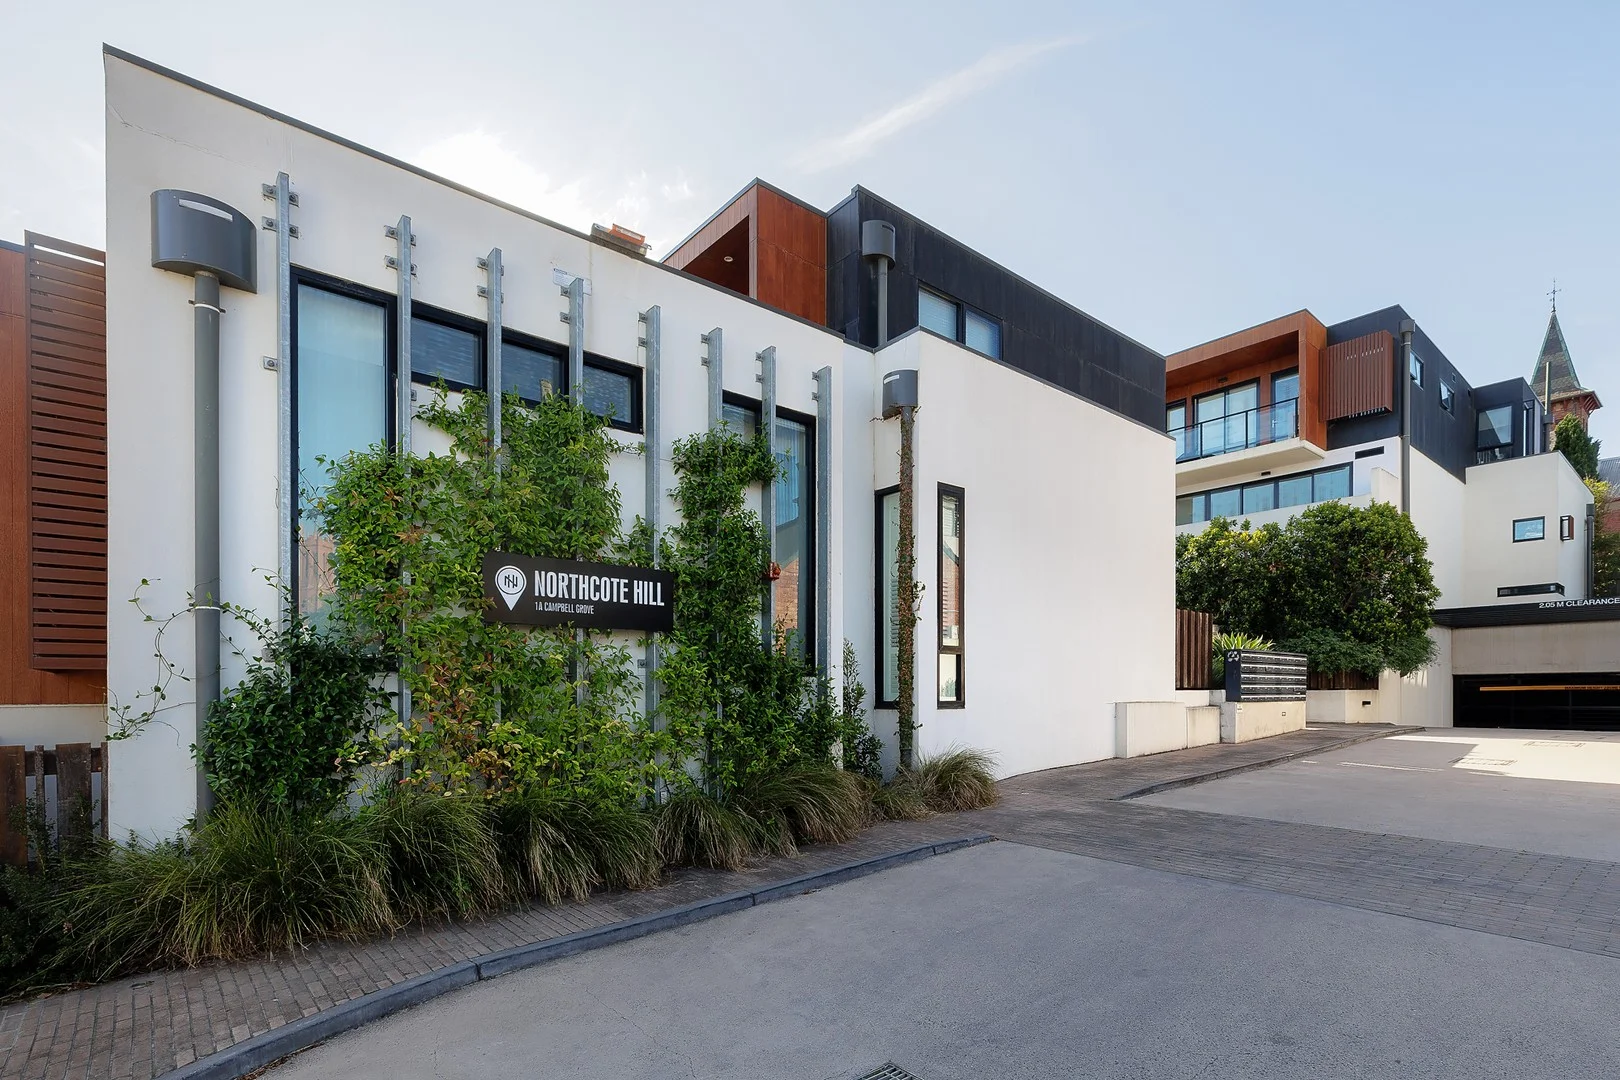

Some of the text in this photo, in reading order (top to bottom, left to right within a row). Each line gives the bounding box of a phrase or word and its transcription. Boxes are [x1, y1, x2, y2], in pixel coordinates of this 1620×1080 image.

[534, 570, 665, 606] NORTHCOTE HILL
[535, 601, 595, 615] 1A CAMPBELL GROVE
[1565, 597, 1620, 607] CLEARANCE
